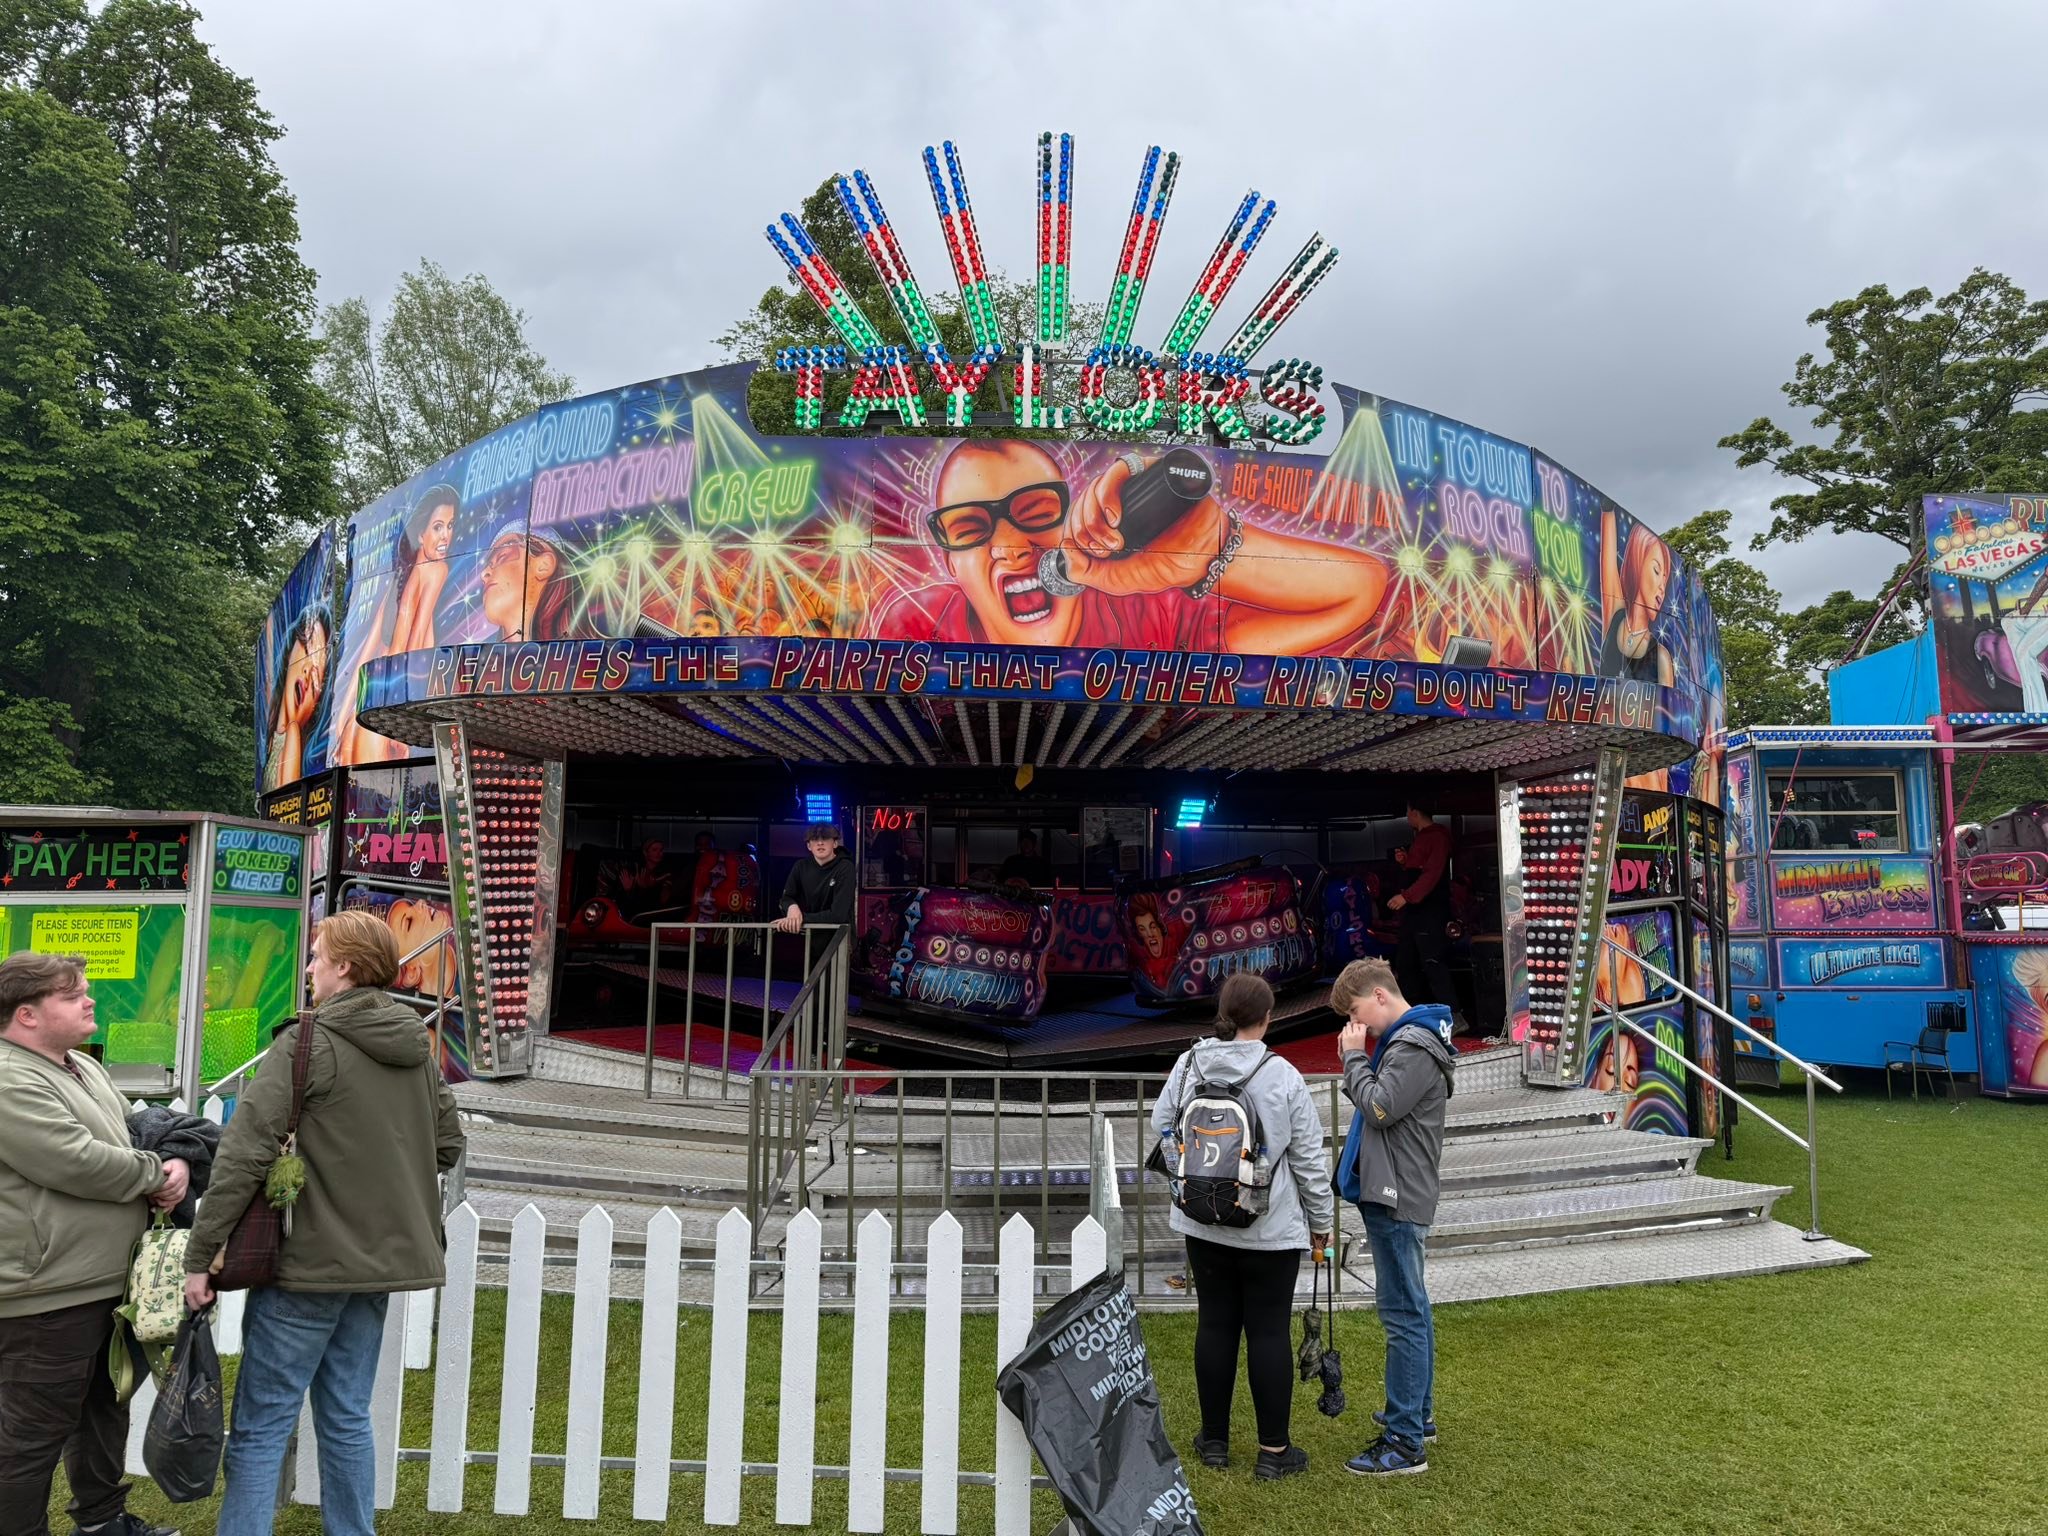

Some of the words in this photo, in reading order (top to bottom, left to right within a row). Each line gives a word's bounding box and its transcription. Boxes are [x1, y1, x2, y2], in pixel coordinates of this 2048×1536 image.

[776, 343, 1327, 445] TAYLORS
[464, 402, 614, 499] FAIRGROUND
[1395, 412, 1429, 471] IN
[1440, 428, 1530, 504] TOWN
[1537, 461, 1567, 521] TO
[531, 442, 696, 524] ATTRACTION
[1169, 466, 1206, 480] SHURE
[1231, 463, 1260, 501] BIG
[1262, 465, 1313, 513] SHOUT
[698, 463, 813, 523] CREW
[2010, 498, 2048, 532] RI
[1443, 484, 1527, 556] ROCK
[1534, 512, 1581, 583] YOU
[1965, 538, 2013, 556] Fabulous
[1944, 554, 1976, 572] LAS
[1980, 539, 2042, 563] VEGAS
[1972, 561, 2013, 573] NEVADA
[427, 638, 634, 697] REACHES
[647, 646, 739, 681] THE
[770, 637, 931, 693] PARTS
[944, 651, 1060, 690] THAT
[1084, 649, 1243, 704] OTHER
[1264, 656, 1398, 710] RIDES
[1416, 669, 1528, 710] DON'T
[1547, 674, 1657, 728] REACH
[1643, 806, 1670, 833] AND
[12, 843, 78, 877] PAY
[86, 842, 179, 876] HERE
[217, 830, 255, 848] BUY
[258, 833, 300, 855] YOUR
[226, 849, 291, 872] TOKENS
[1776, 858, 1881, 898] MIDNIGHT
[231, 870, 284, 891] HERE
[1821, 884, 1930, 922] Express
[36, 920, 68, 930] PLEASE
[71, 919, 104, 930] SECURE
[107, 919, 133, 929] ITEMS
[45, 933, 54, 943] IN
[57, 933, 80, 943] YOUR
[82, 932, 122, 943] POCKETS
[889, 886, 931, 998] TAYLORS
[107, 966, 121, 974] etc.
[1810, 947, 1881, 985] ULTIMATE
[1883, 944, 1921, 967] HIGH
[906, 959, 1026, 1011] FAIRGROUND
[1117, 1362, 1146, 1396] TIDY
